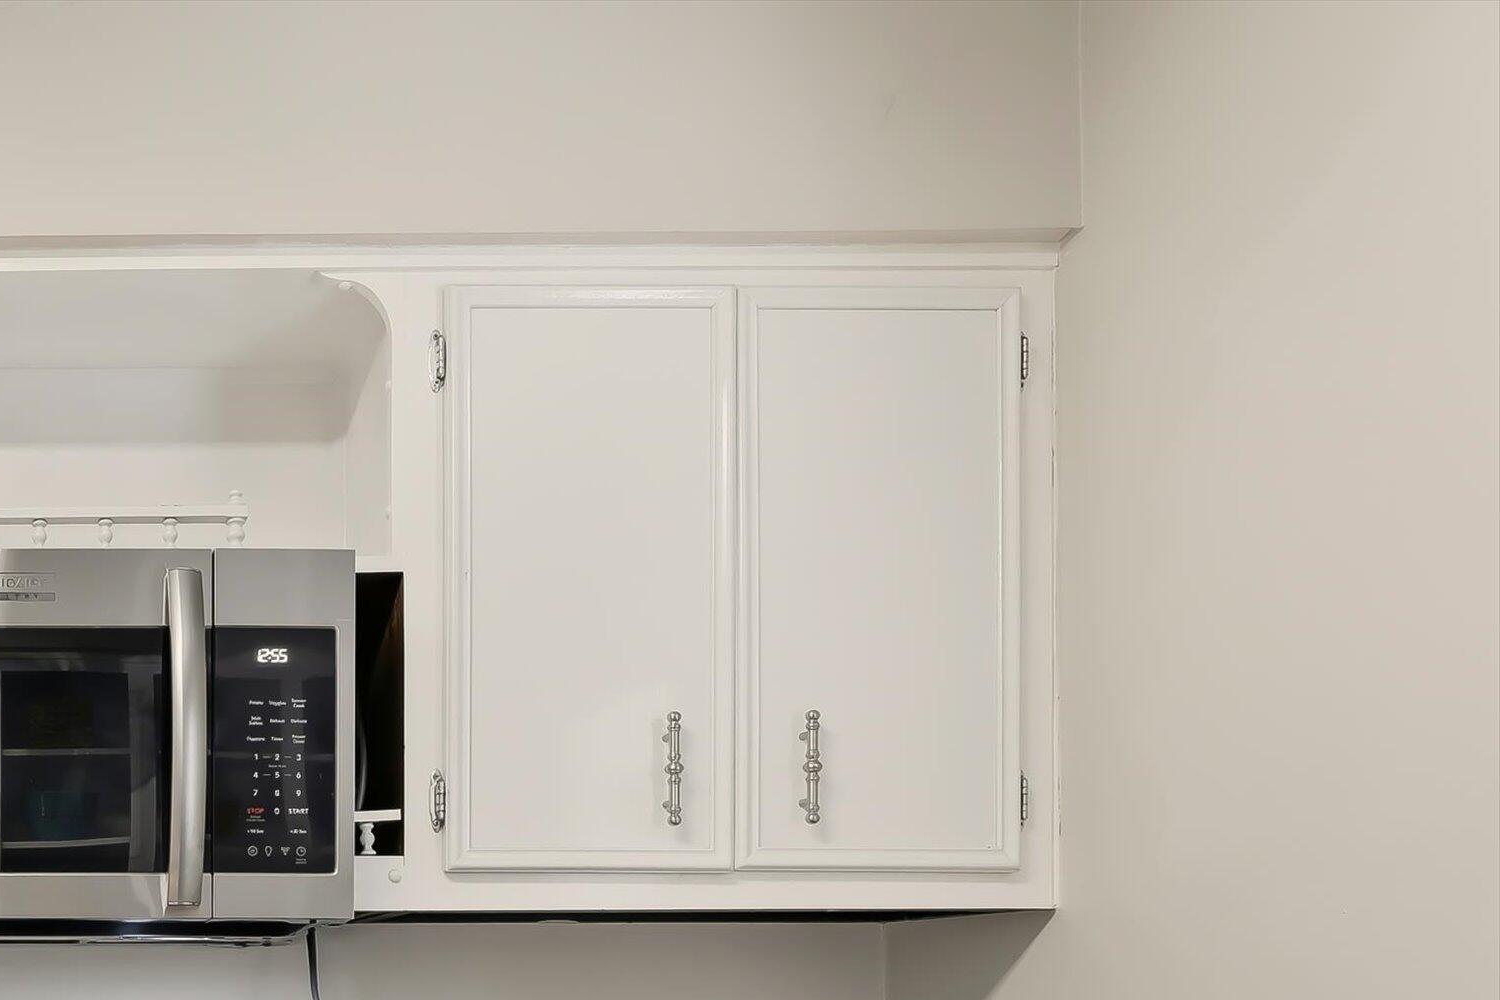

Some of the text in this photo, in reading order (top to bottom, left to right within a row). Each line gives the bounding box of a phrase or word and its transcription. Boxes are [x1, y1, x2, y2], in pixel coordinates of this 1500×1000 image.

[253, 753, 259, 761] 1
[274, 753, 280, 761] 2
[295, 753, 302, 761] 3
[253, 771, 259, 779] 4
[274, 771, 280, 779] 5
[295, 771, 302, 779] 6
[253, 788, 259, 797] 7
[295, 788, 302, 797] 9
[288, 807, 309, 815] START
